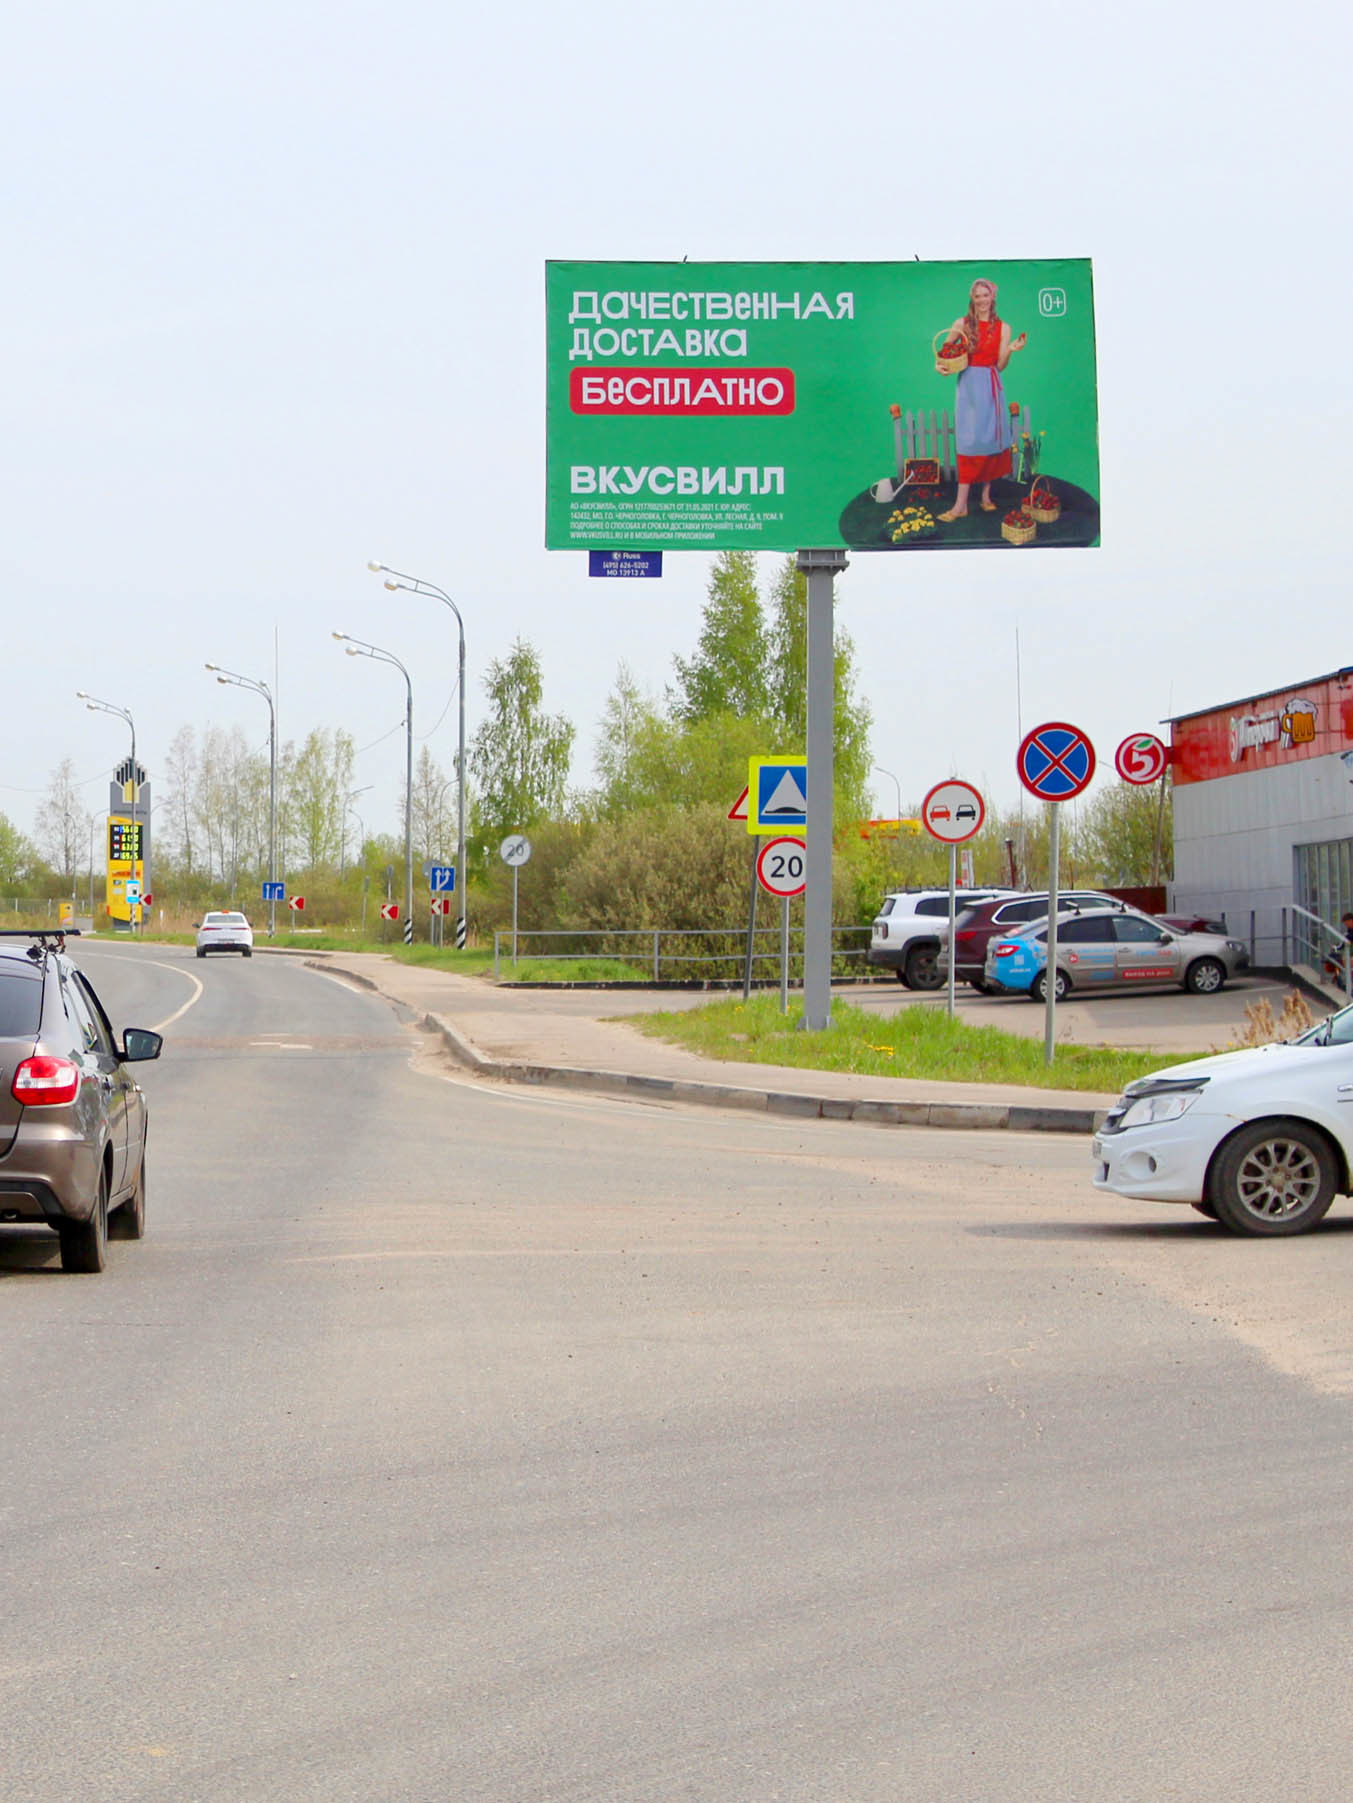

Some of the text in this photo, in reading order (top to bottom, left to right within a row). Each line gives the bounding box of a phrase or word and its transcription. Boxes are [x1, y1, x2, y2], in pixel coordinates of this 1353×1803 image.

[1043, 293, 1063, 312] 0+
[570, 466, 784, 495] ВКУСВИЛЛ
[770, 855, 803, 878] 20
